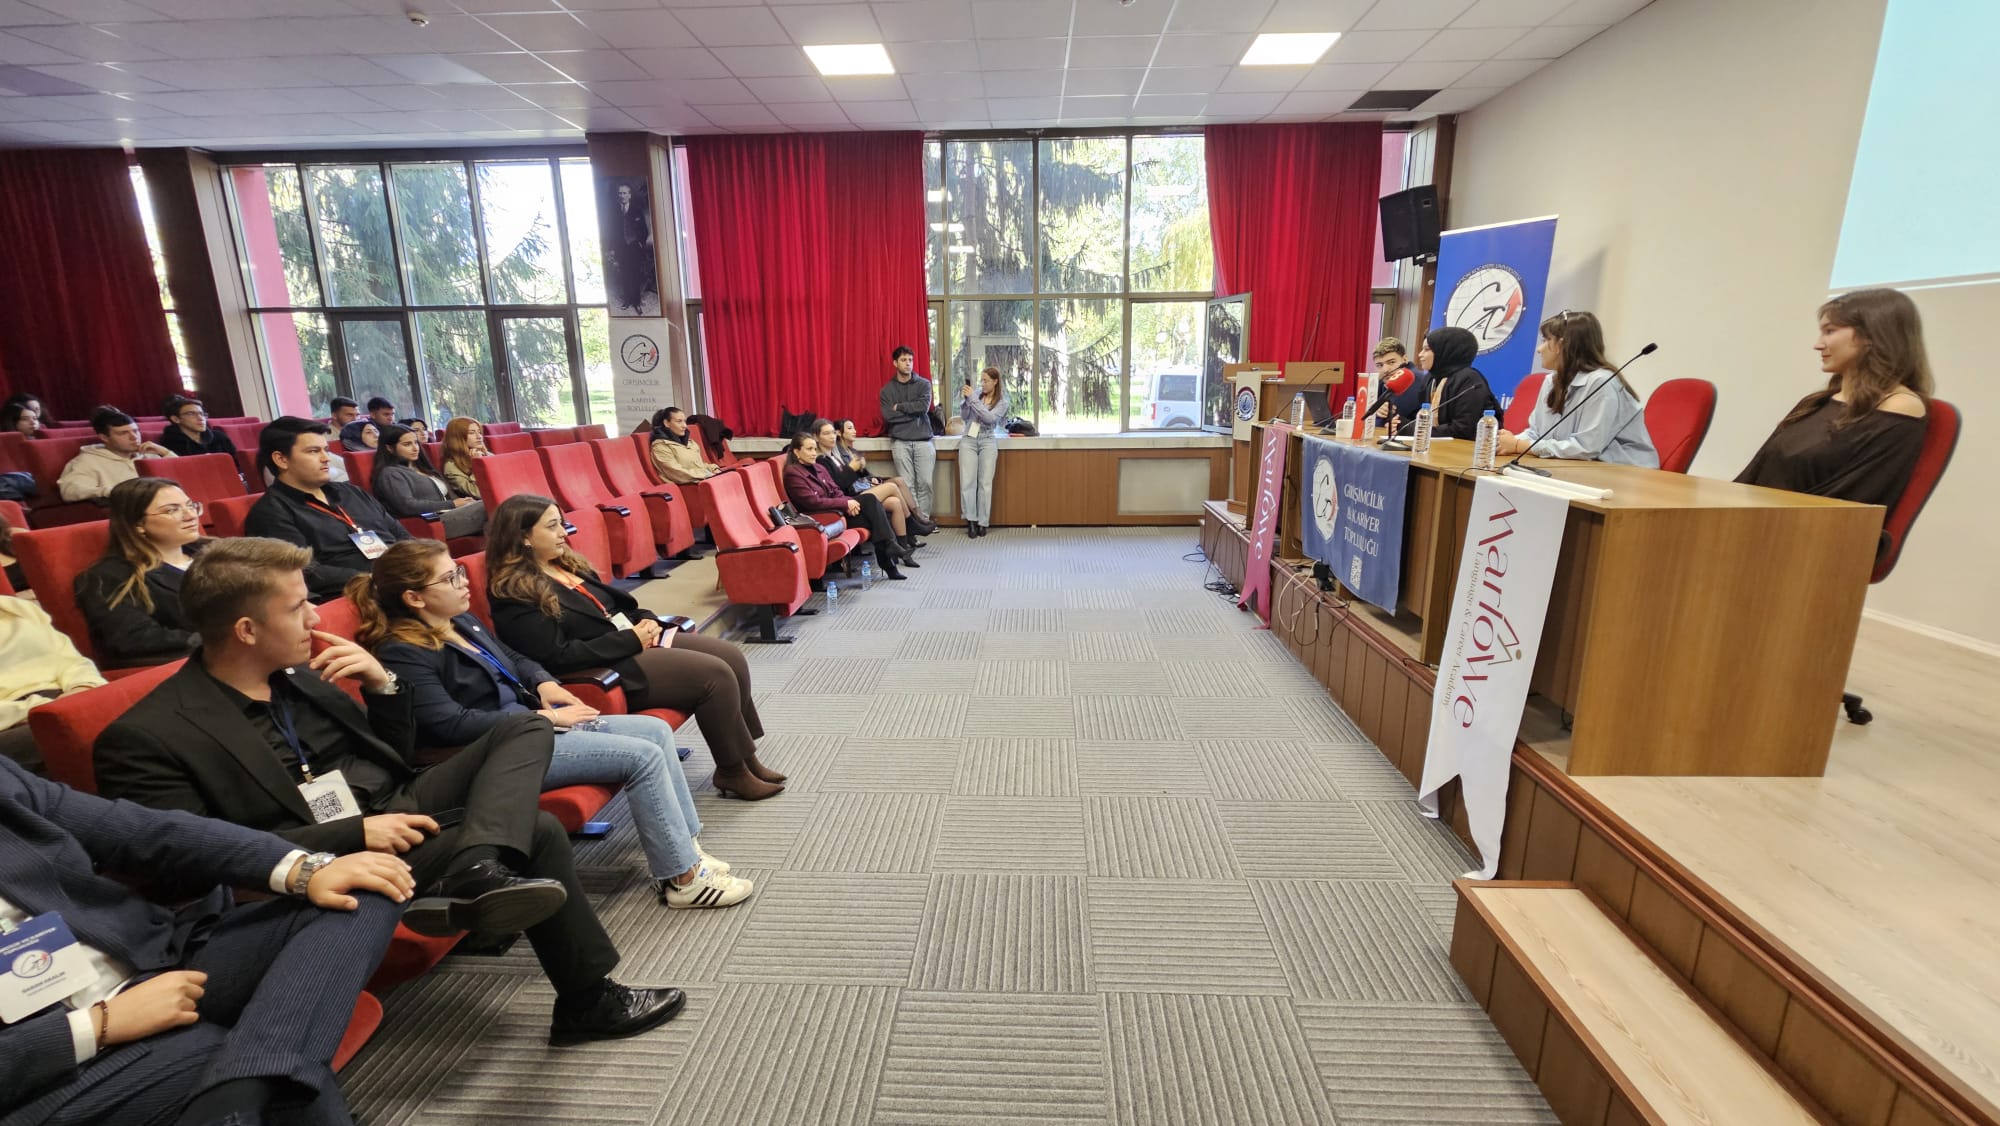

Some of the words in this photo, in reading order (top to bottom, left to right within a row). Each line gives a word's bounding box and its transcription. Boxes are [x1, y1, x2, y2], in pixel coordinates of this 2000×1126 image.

[1466, 551, 1484, 607] Language
[1463, 608, 1472, 617] &
[1456, 621, 1470, 657] Career
